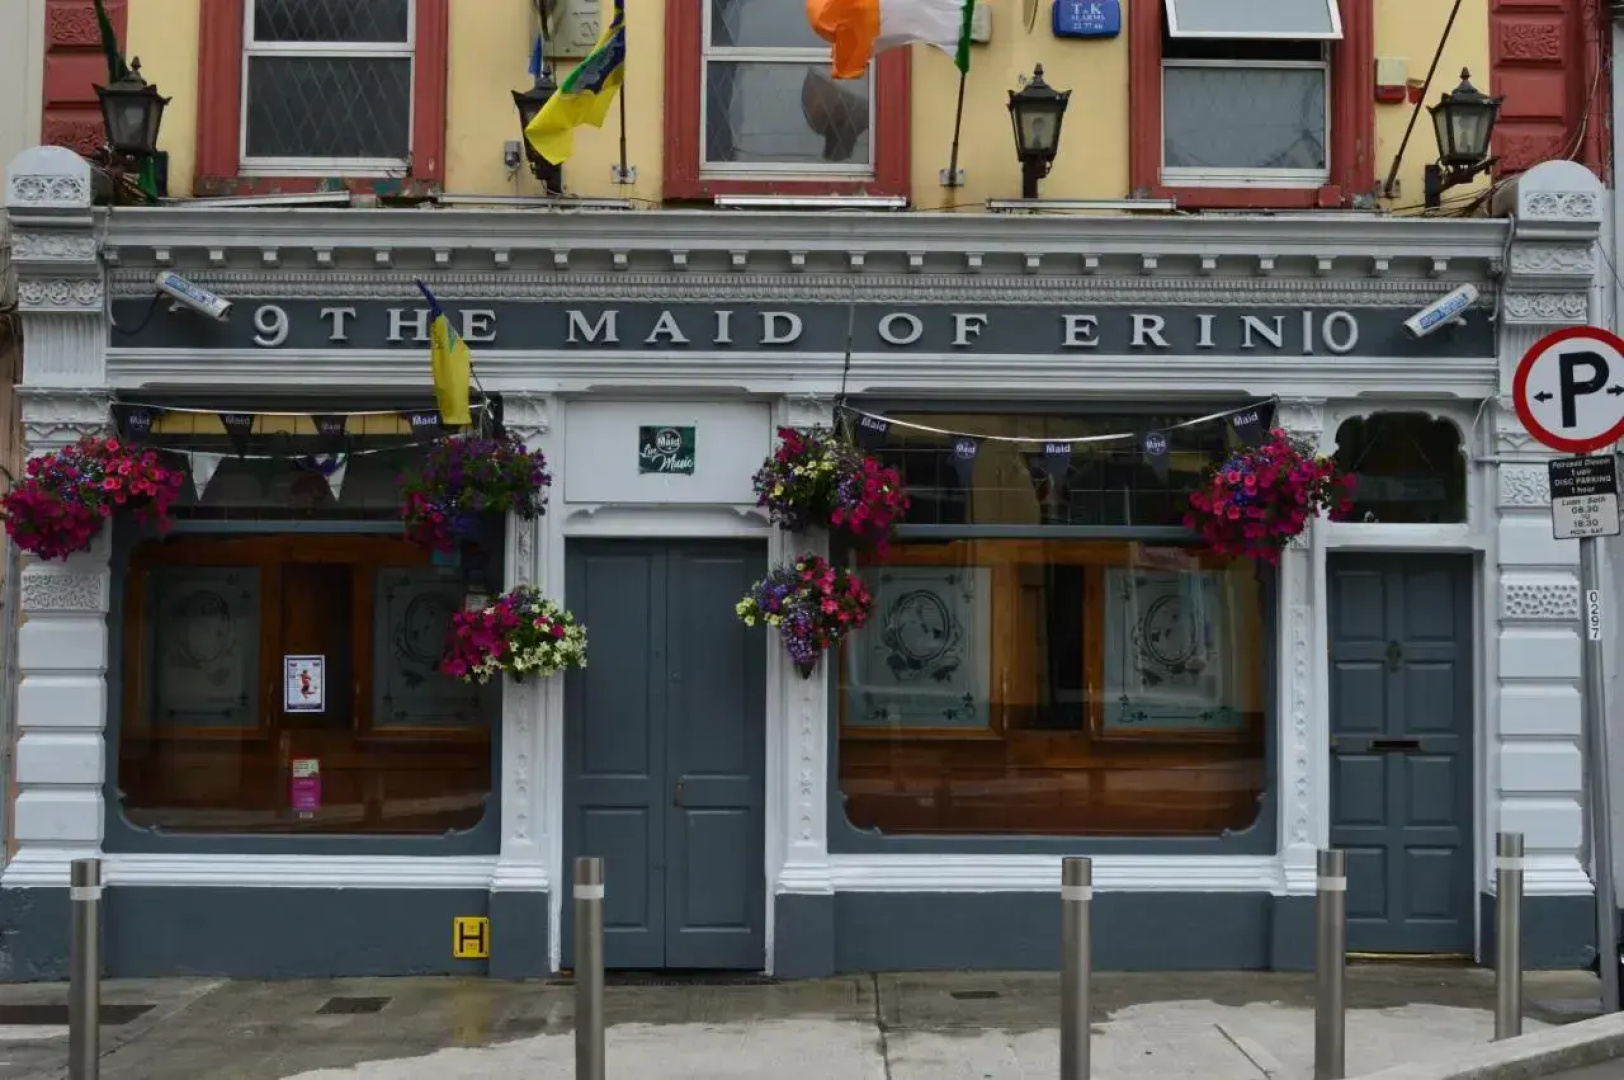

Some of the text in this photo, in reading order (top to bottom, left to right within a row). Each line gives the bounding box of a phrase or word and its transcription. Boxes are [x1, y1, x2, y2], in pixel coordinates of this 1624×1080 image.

[1071, 4, 1082, 14] T
[1090, 3, 1103, 14] K
[253, 304, 290, 347] 9
[319, 306, 498, 342] THE
[565, 309, 803, 345] MAID
[877, 312, 989, 346] OF
[1061, 313, 1285, 348] ERIN
[1558, 351, 1610, 428] P
[412, 416, 438, 426] Maid
[861, 417, 887, 432] Maid
[1234, 411, 1259, 427] Maid
[1045, 442, 1071, 454] Maid
[1554, 475, 1611, 487] DISC PARKING
[1589, 591, 1600, 639] 0297
[459, 922, 484, 954] H
